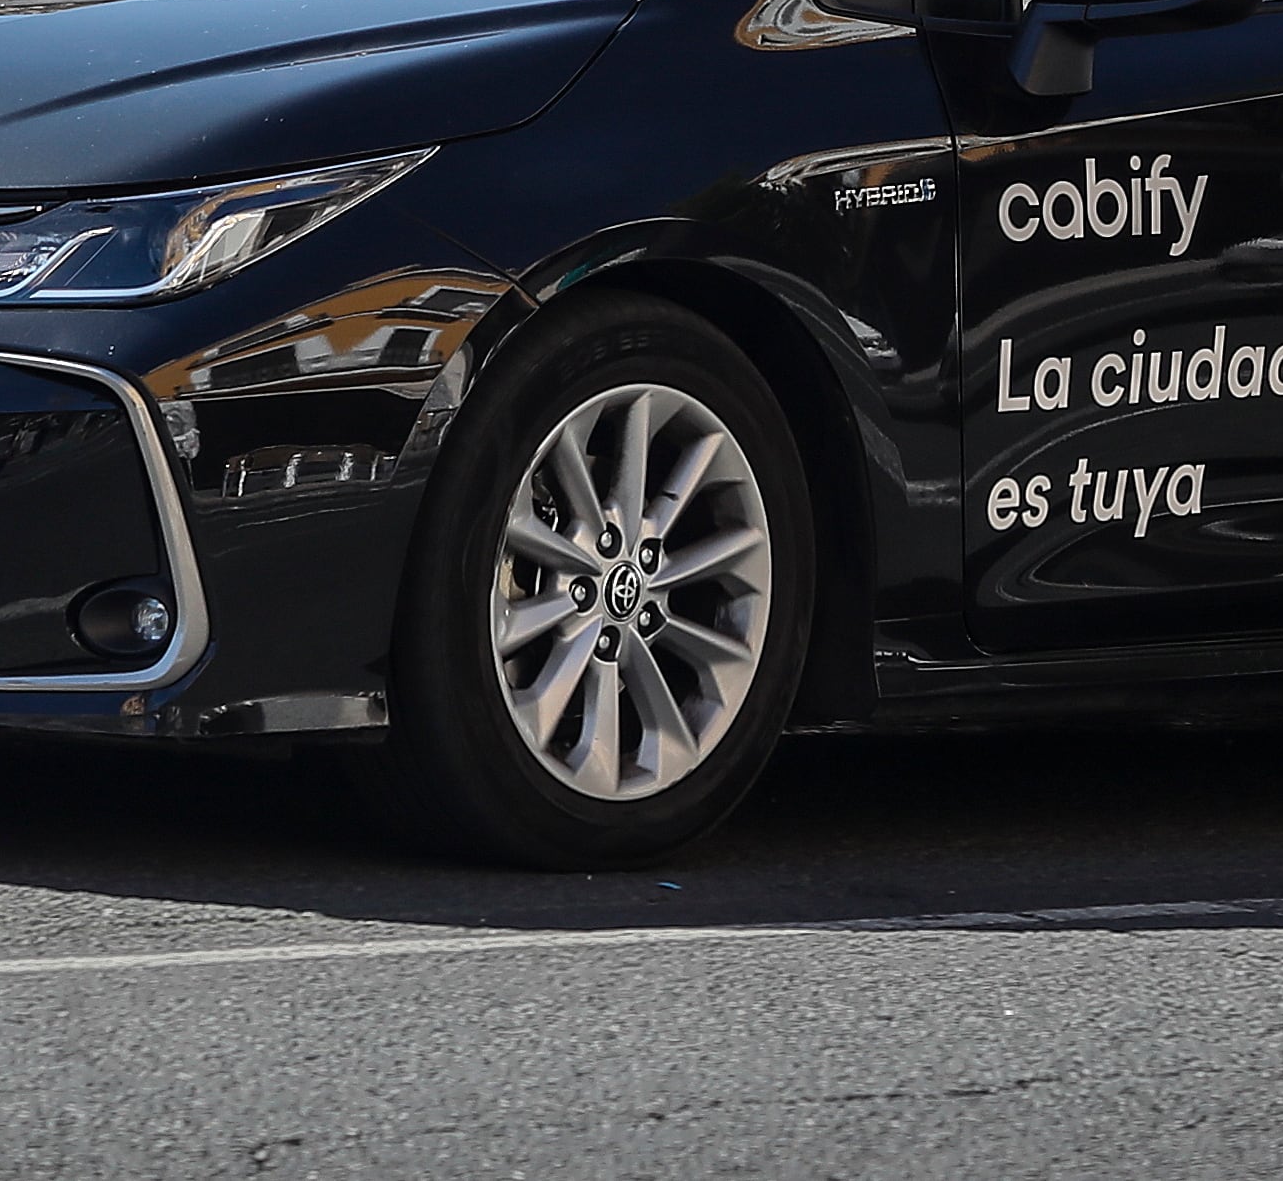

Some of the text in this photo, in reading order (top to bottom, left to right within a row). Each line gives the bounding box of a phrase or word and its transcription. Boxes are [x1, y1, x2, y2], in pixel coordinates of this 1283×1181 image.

[999, 154, 1208, 256] cabify
[997, 339, 1072, 412] La
[987, 458, 1205, 538] es tuya
